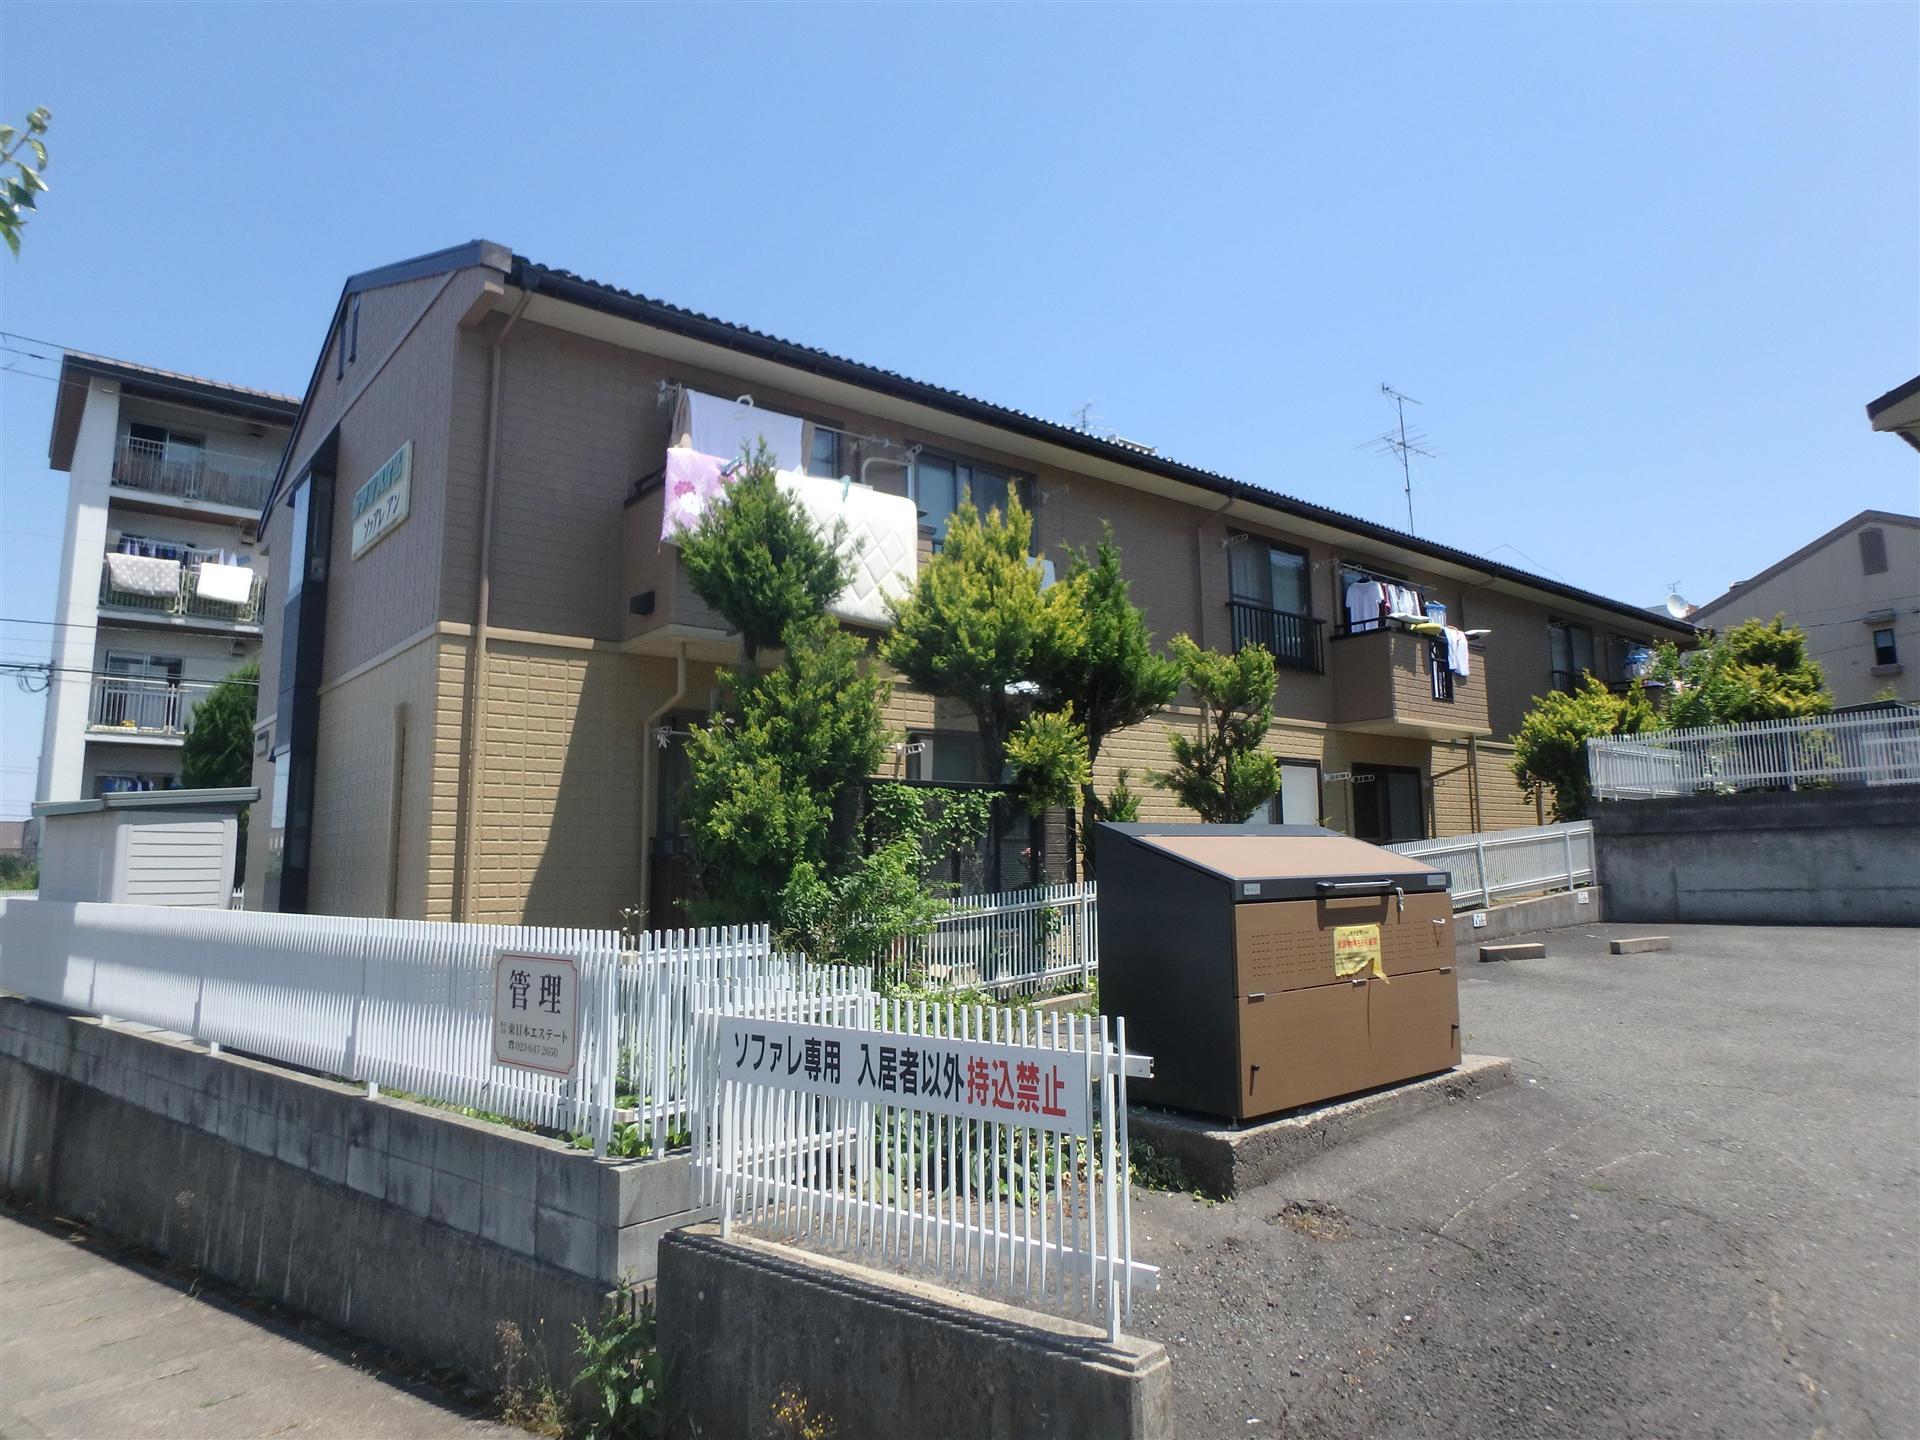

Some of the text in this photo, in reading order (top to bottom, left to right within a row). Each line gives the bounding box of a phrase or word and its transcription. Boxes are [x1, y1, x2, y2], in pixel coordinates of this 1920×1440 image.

[509, 969, 562, 1014] 管理
[509, 1023, 568, 1044] 東日本エステート
[734, 1032, 841, 1085] ソファレ専用
